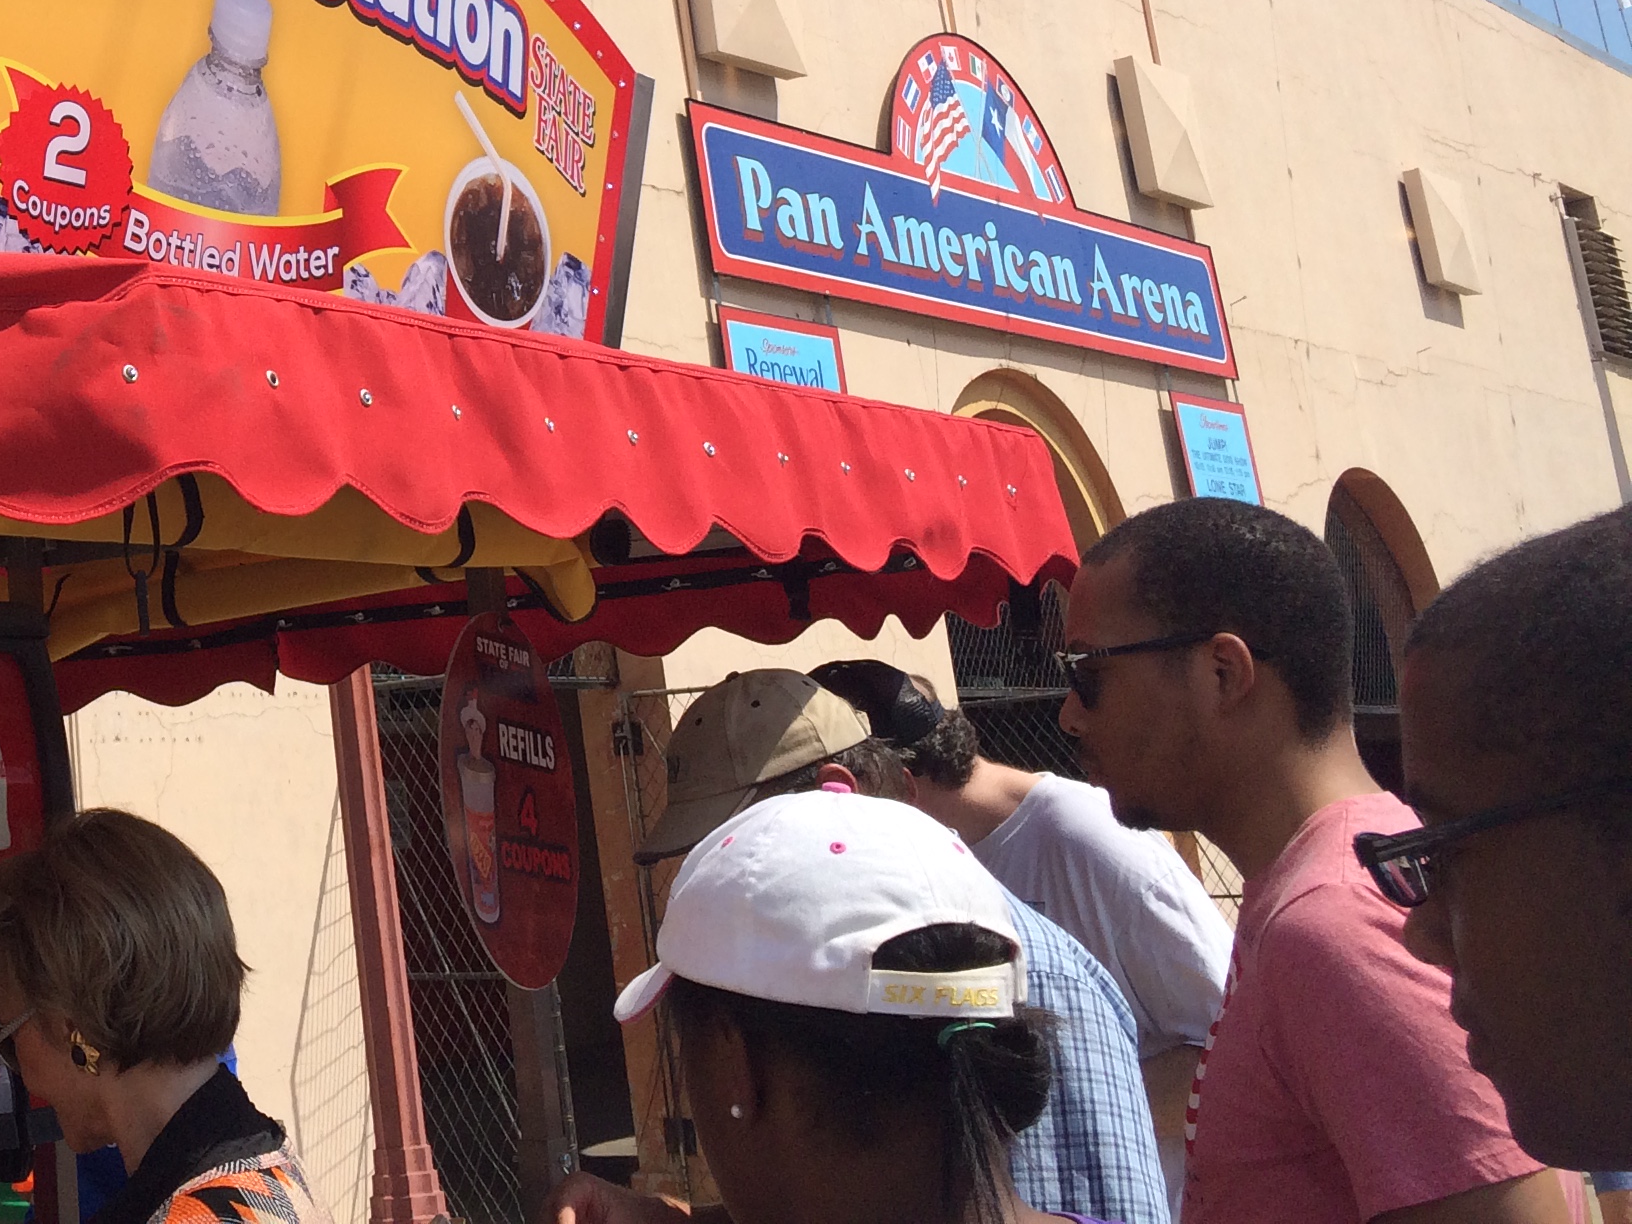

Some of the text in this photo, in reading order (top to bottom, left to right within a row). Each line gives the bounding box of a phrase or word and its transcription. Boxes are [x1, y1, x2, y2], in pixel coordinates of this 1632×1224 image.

[530, 33, 595, 144] STATE
[42, 100, 90, 187] 2
[533, 92, 587, 194] FAIR
[11, 180, 112, 231] Coupons
[123, 208, 340, 281] Bottled Water
[734, 155, 1209, 339] Pan American Arena
[745, 347, 824, 388] Renewal
[476, 636, 530, 667] STATE FAIR
[499, 659, 508, 669] OF
[498, 722, 556, 770] REFILLS
[520, 792, 538, 836] 4
[501, 840, 571, 880] COUPONS
[881, 983, 999, 1007] SIX FLAGS
